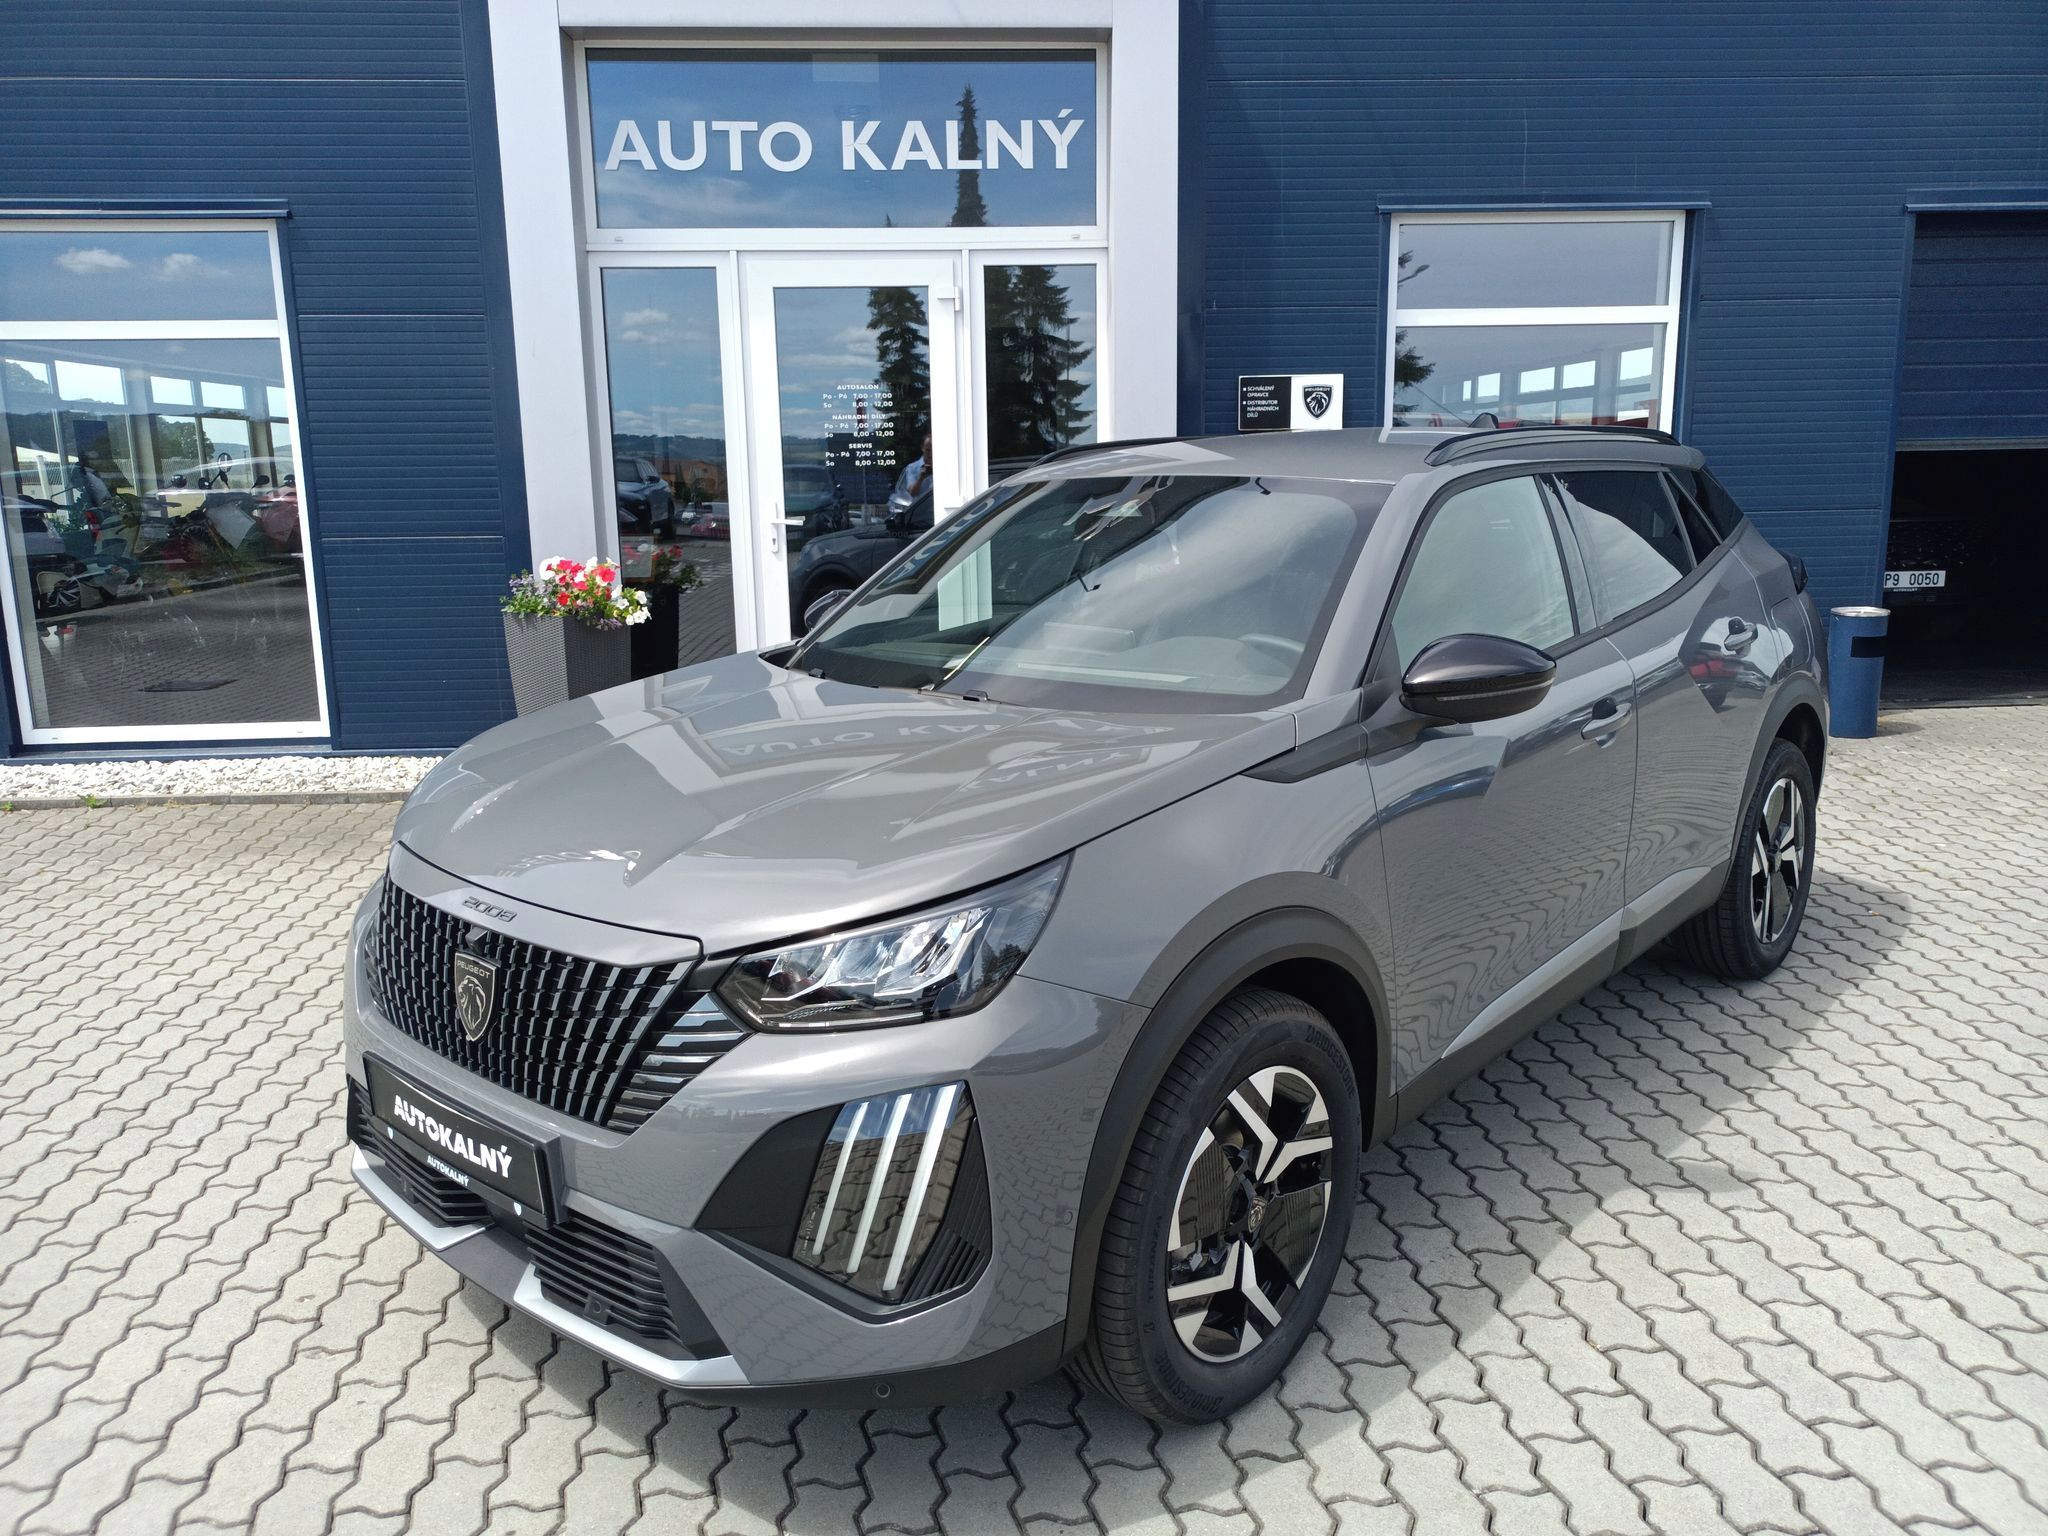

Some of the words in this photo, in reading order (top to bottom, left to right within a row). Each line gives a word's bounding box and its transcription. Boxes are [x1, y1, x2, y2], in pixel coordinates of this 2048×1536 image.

[604, 119, 813, 172] AUTO
[842, 108, 1085, 171] KALNÝ
[874, 392, 892, 400] 17,00
[1909, 572, 1940, 586] 0050
[462, 896, 518, 923] 2008
[457, 959, 491, 979] PEUGEOT
[1304, 1025, 1356, 1100] BRIDGESTONE
[393, 1094, 513, 1179] AUTOKALNÝ
[427, 1154, 470, 1187] AUTOKALNÝ
